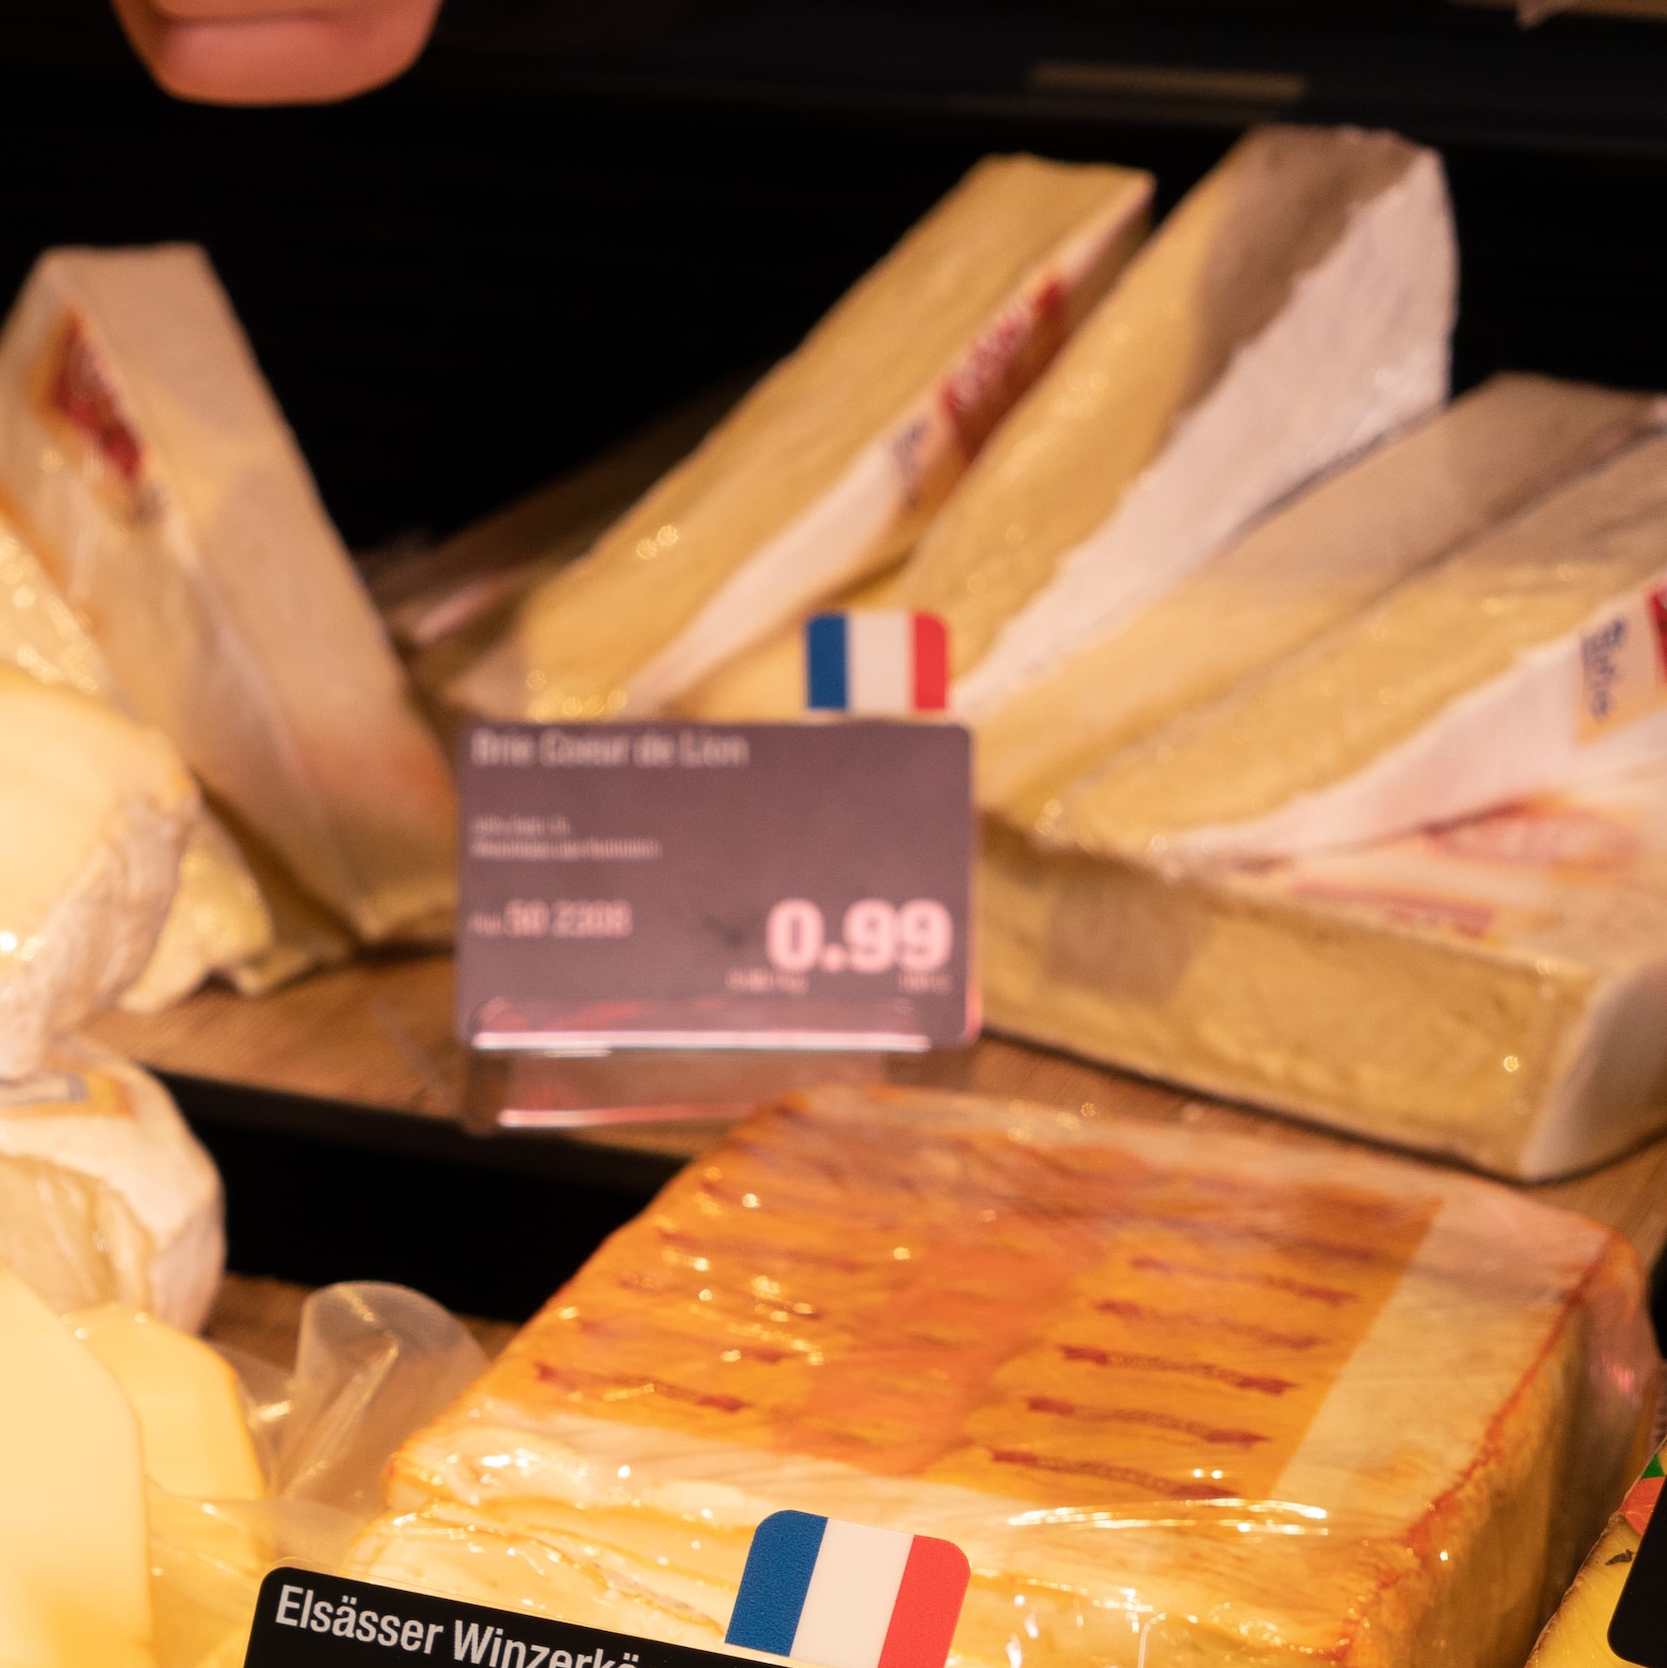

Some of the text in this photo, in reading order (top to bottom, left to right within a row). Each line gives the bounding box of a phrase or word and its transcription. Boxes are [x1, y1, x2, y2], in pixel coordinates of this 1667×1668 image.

[470, 729, 751, 767] Brie Coeur de Lion
[767, 897, 954, 974] 0.99
[274, 1583, 444, 1656] Elsässer
